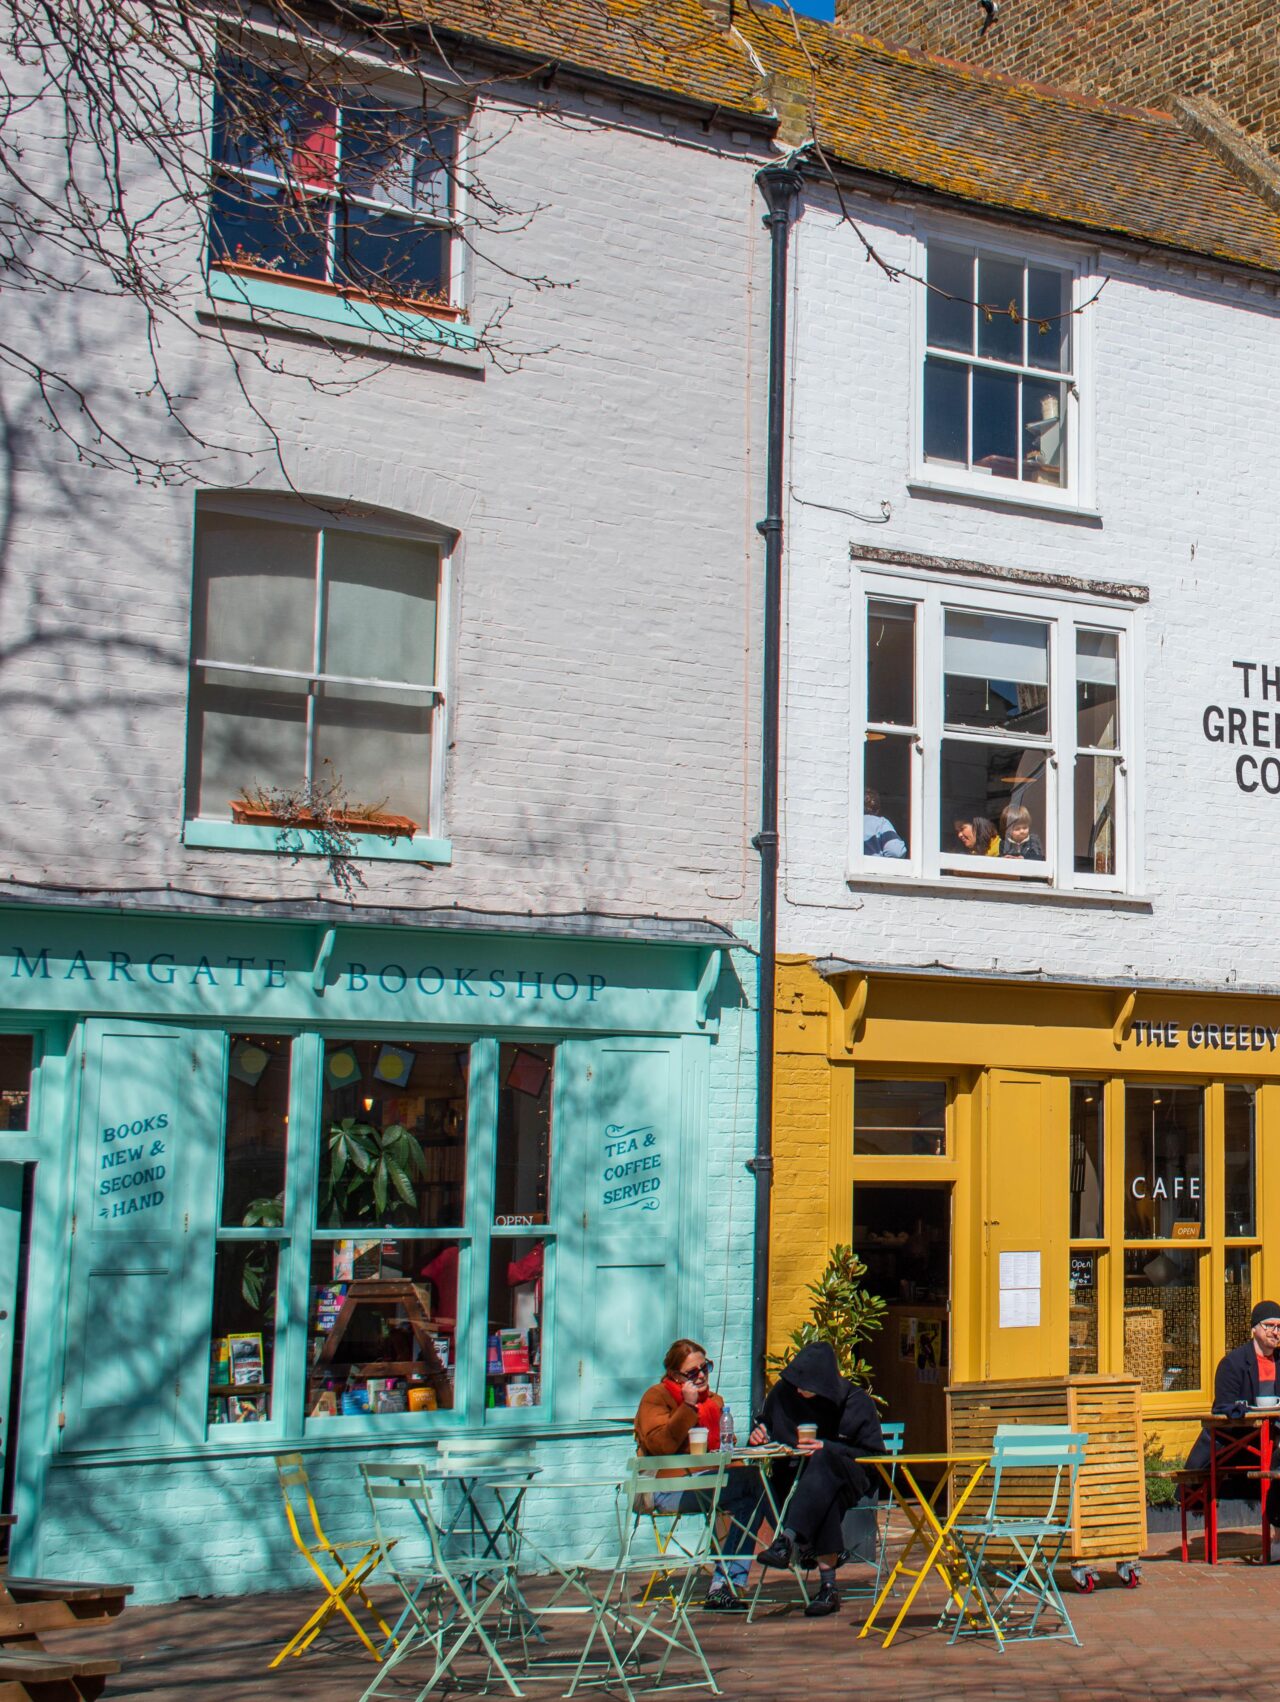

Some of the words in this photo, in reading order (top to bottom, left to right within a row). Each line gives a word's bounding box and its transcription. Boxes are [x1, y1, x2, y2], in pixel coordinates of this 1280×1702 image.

[11, 946, 287, 988] MARGATE
[345, 962, 607, 1002] BOOKSHOP
[1132, 1020, 1180, 1047] THE
[1188, 1022, 1280, 1052] GREEDY
[103, 1113, 169, 1143] BOOKS
[101, 1144, 144, 1170] NEW
[150, 1140, 166, 1157] &
[604, 1138, 638, 1158] TEA
[643, 1133, 656, 1147] &
[100, 1165, 166, 1196] SECOND
[603, 1153, 662, 1182] COFFEE
[603, 1177, 661, 1205] SERVED
[1132, 1176, 1200, 1199] CAFE
[112, 1191, 165, 1218] HAND
[495, 1215, 534, 1226] OPEN
[1177, 1227, 1196, 1236] OPEN
[1071, 1259, 1091, 1271] Open
